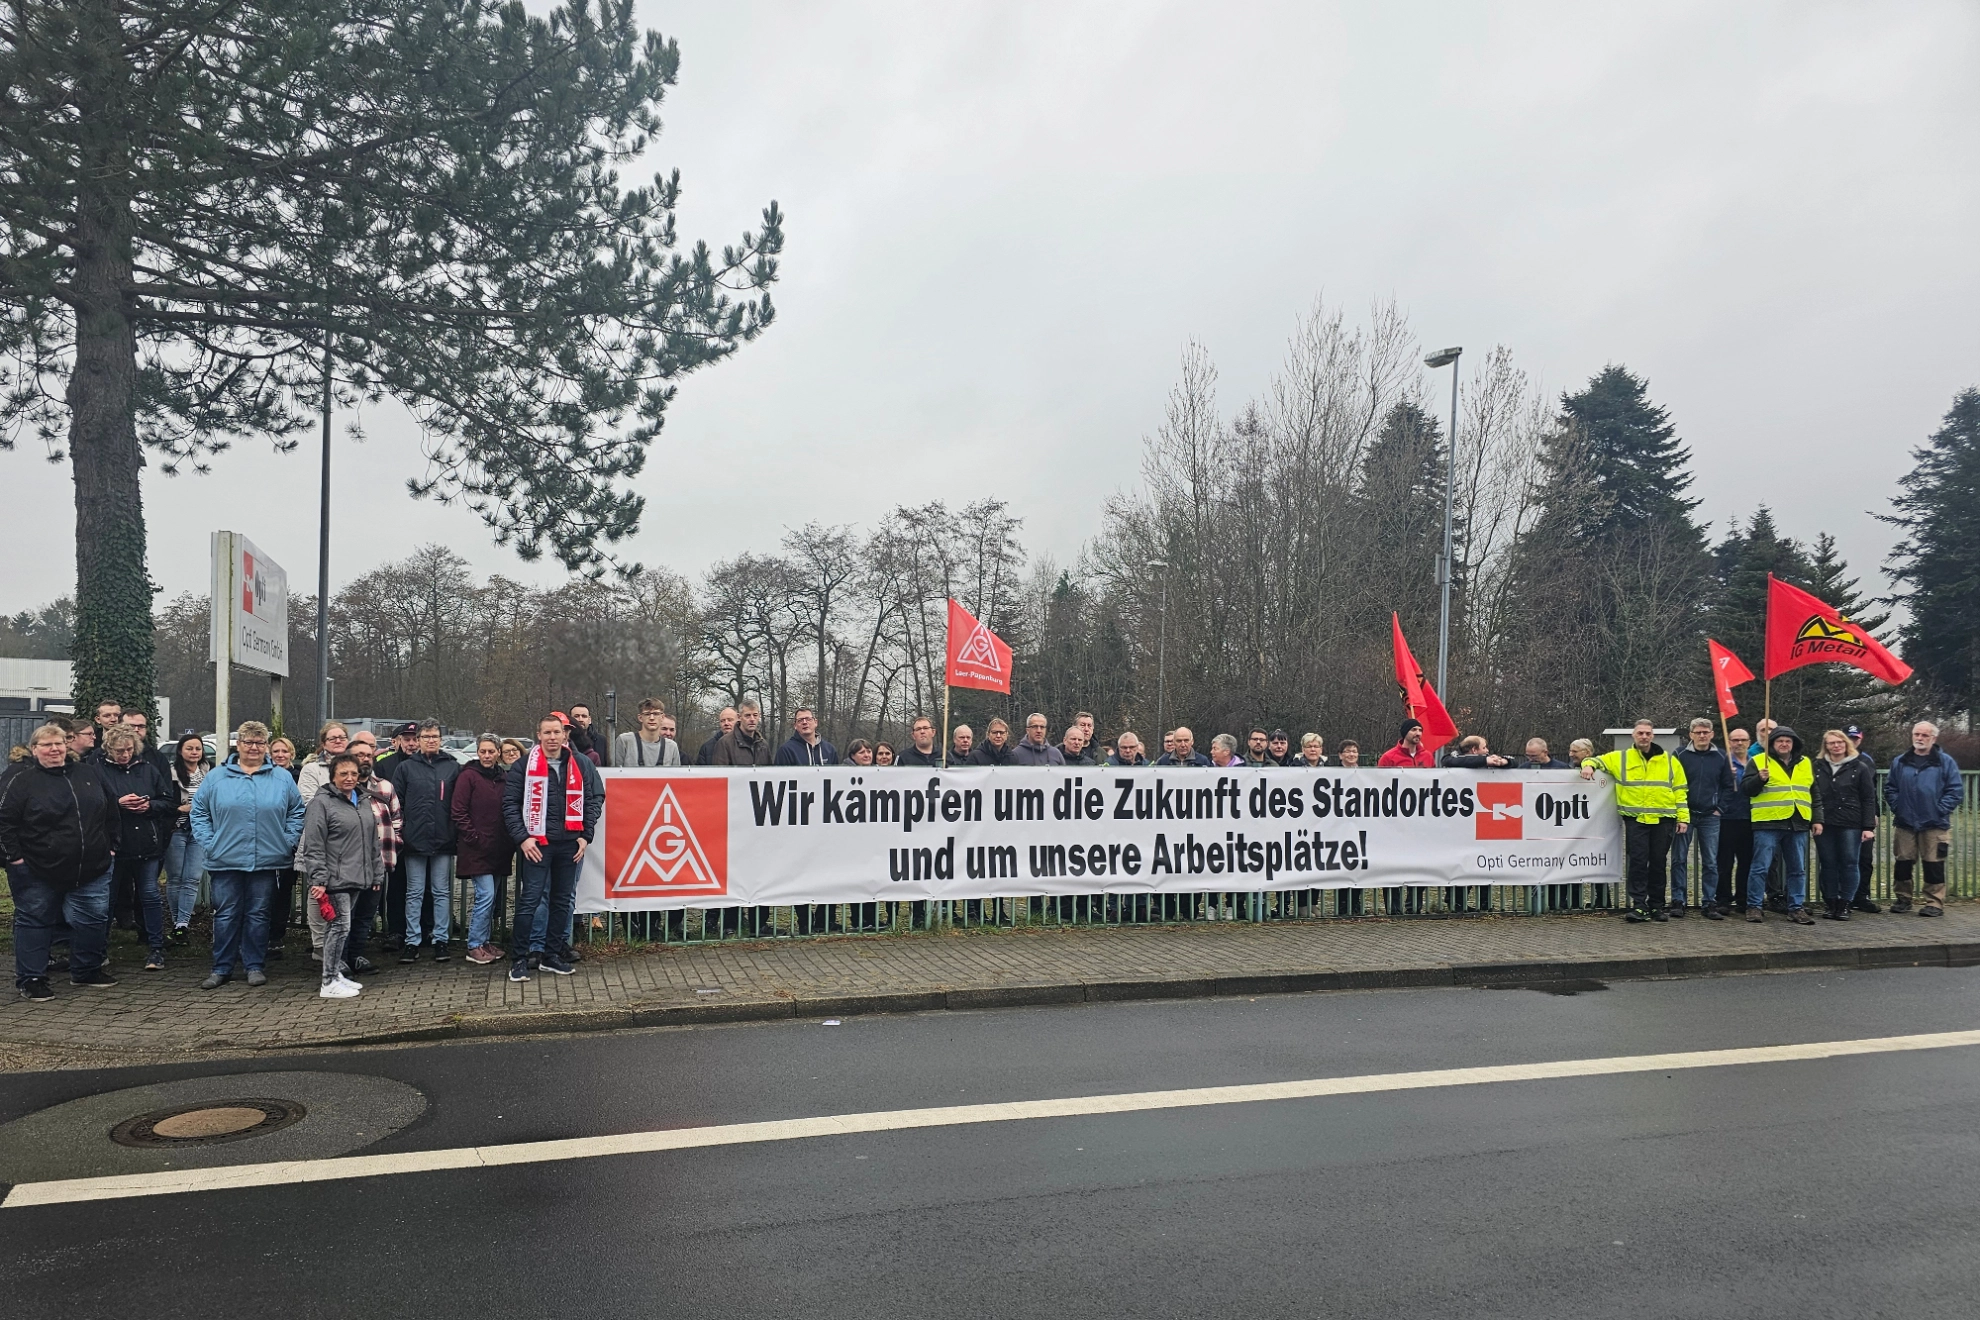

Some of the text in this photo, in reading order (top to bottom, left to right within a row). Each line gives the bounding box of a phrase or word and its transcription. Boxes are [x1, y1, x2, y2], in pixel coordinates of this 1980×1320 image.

[1790, 641, 1867, 660] IG Metall
[531, 781, 542, 813] WIR
[750, 777, 1474, 832] Wir kämpfen um die Zukunft des Standortes
[1535, 792, 1591, 826] Opti
[890, 829, 1368, 881] und um unsere Arbeitsplätze!
[1477, 852, 1608, 871] Opti Germany GmbH
